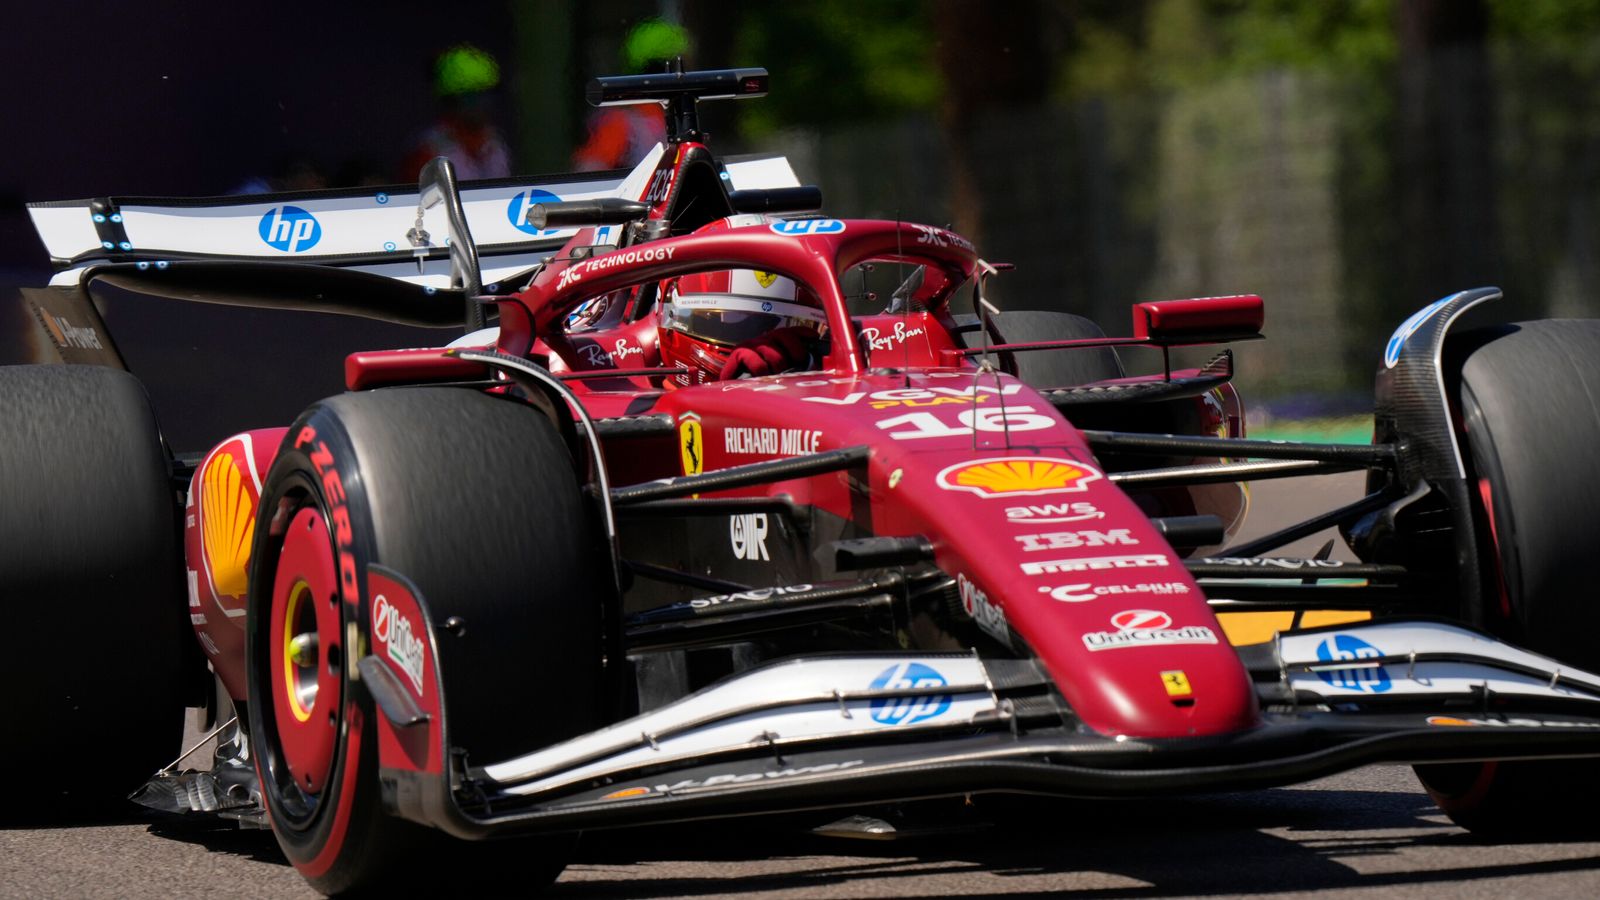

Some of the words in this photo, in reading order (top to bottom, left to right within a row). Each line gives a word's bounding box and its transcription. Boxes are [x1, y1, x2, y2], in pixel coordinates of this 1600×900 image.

[266, 205, 315, 253] hp
[586, 247, 676, 272] TECHNOLOGY
[863, 321, 924, 352] Ray-Ban
[577, 339, 644, 367] Ray-Ban
[801, 385, 1023, 405] VGW
[869, 395, 990, 409] PLAY
[875, 405, 1056, 439] 16
[724, 427, 779, 454] RICHARD
[779, 428, 823, 456] MILLE
[294, 425, 316, 449] P
[310, 440, 360, 605] ZERO
[1004, 501, 1099, 519] aws
[1014, 528, 1140, 551] IBM
[1020, 554, 1170, 576] PIRELLI
[1086, 627, 1210, 646] UniCredit
